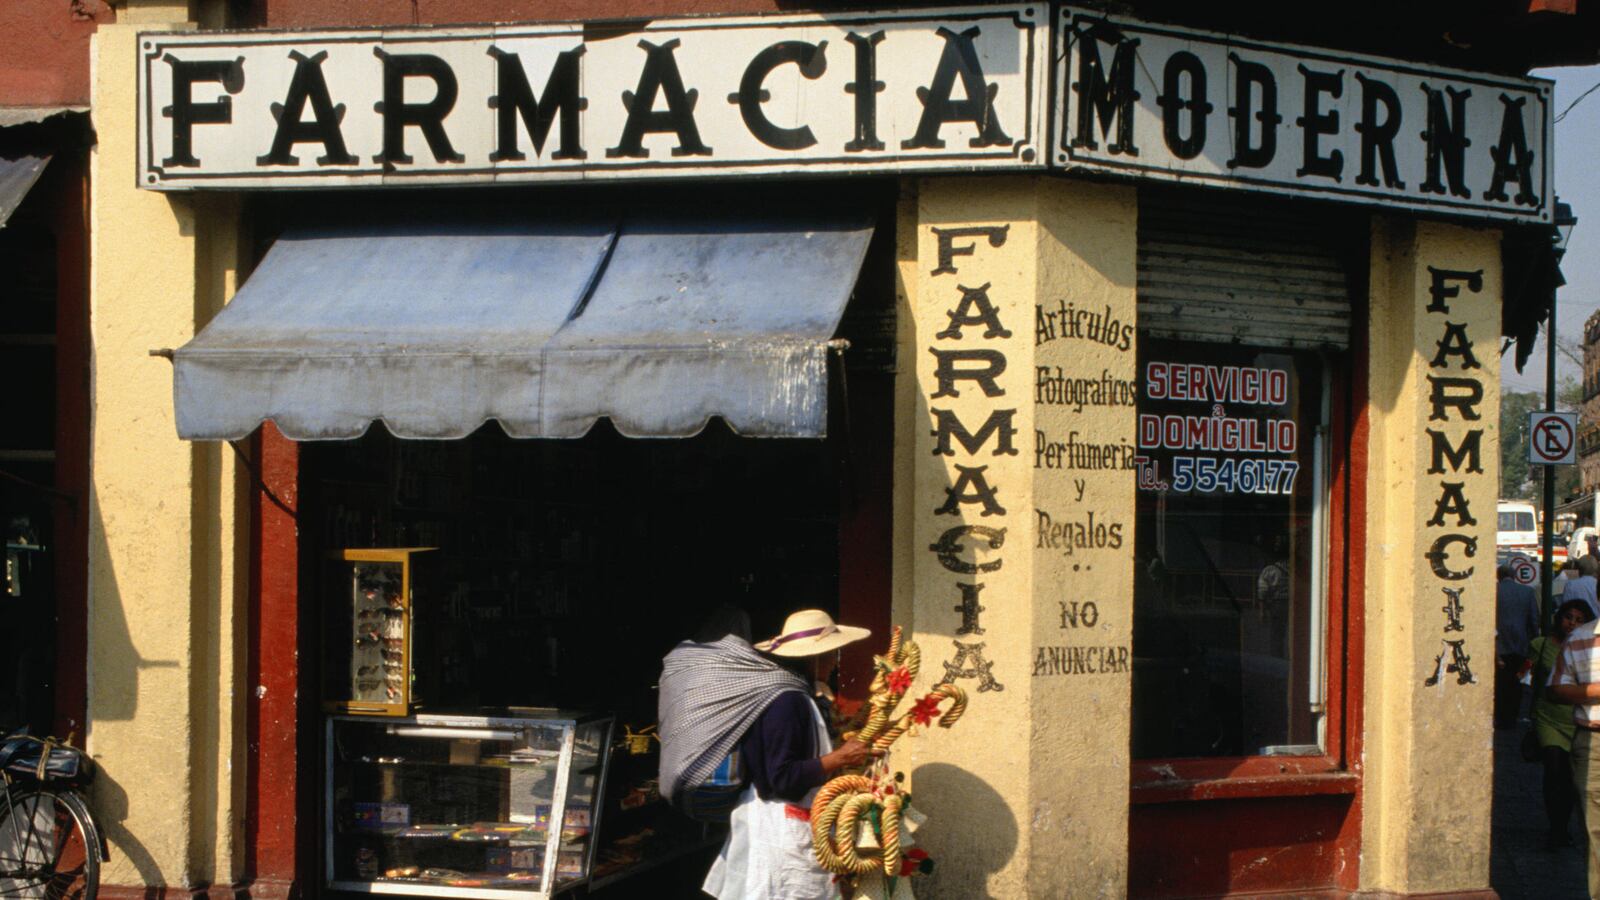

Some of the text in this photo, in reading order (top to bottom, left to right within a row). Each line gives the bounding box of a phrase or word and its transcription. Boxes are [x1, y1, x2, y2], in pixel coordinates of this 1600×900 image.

[162, 25, 1014, 168] FARMACIA
[1072, 27, 1540, 207] MODERNA
[1035, 300, 1134, 352] Articulos
[1035, 366, 1137, 413] Fotograficos
[1147, 362, 1288, 406] SERVICIO
[1211, 403, 1226, 418] a
[1034, 429, 1136, 471] Perfumeria
[1139, 414, 1297, 454] DOMICILIO
[928, 223, 1019, 694] FARMACIA
[1135, 456, 1169, 491] Tel.
[1424, 265, 1485, 688] FARMACIA
[1074, 478, 1086, 503] y
[1035, 508, 1123, 557] Regalos
[1519, 567, 1531, 580] E
[1058, 600, 1099, 629] NO
[1031, 646, 1130, 677] ANUNCIAR
